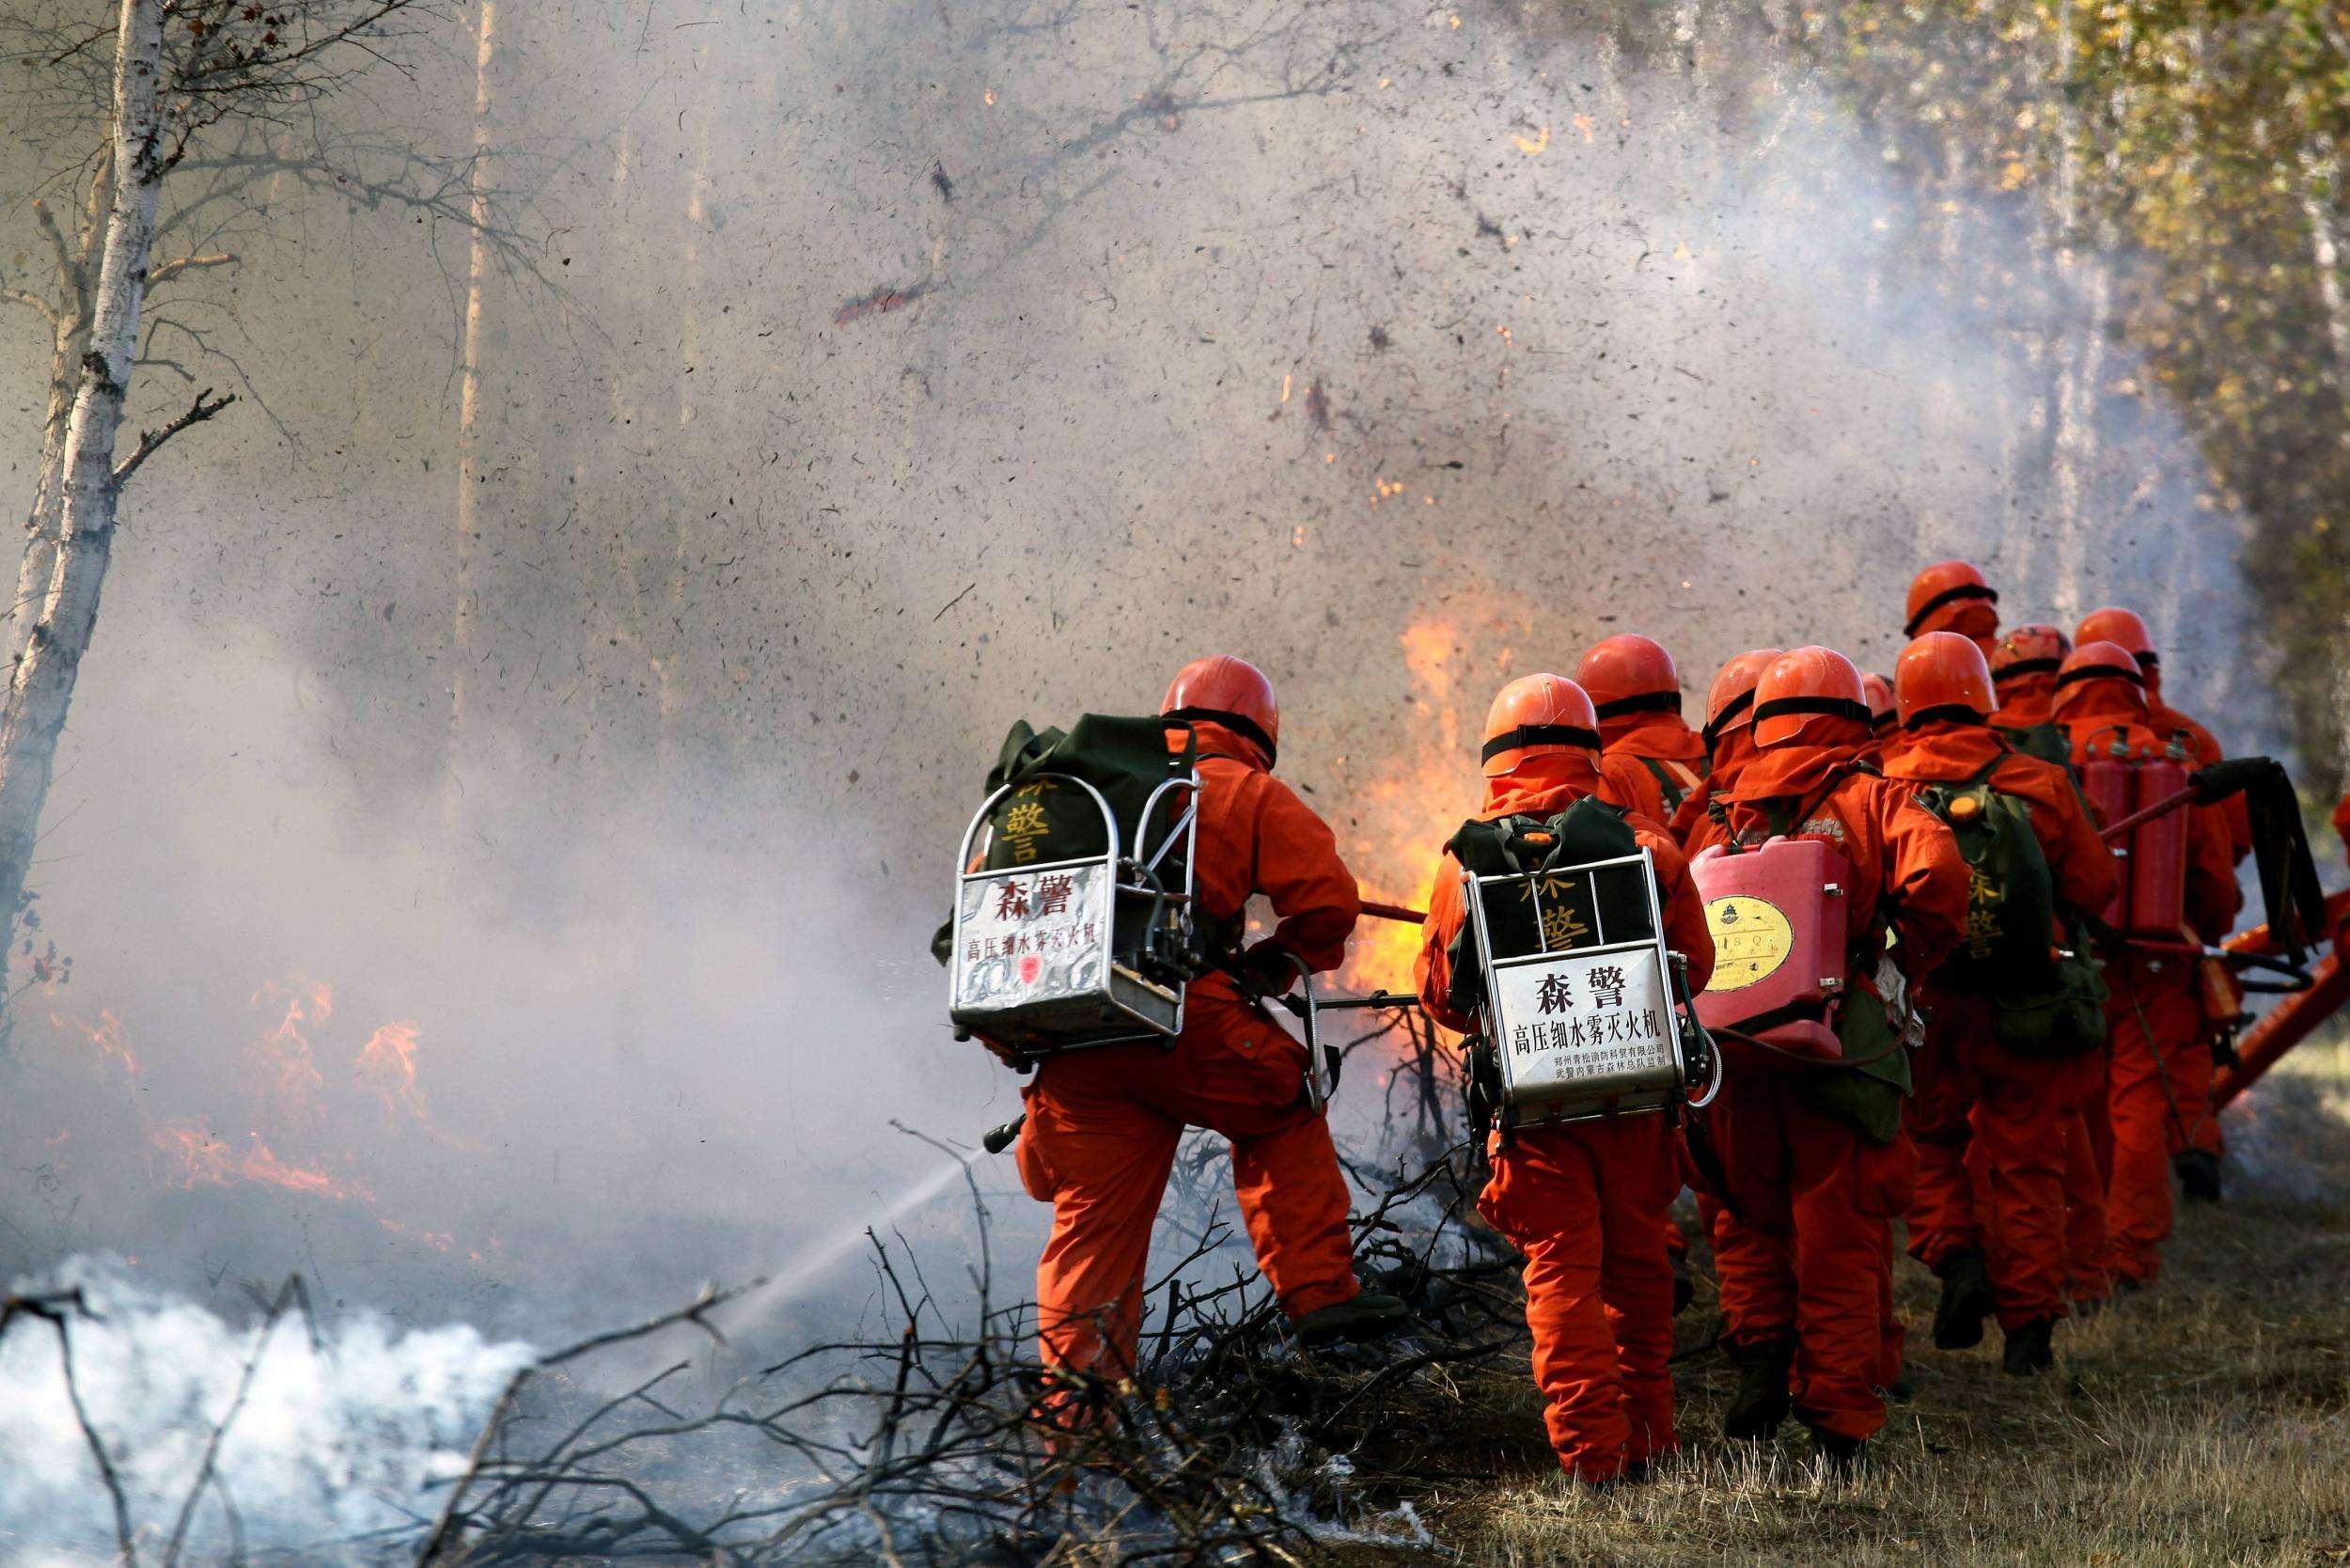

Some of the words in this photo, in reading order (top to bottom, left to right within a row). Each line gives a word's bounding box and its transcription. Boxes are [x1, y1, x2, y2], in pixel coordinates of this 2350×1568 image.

[995, 874, 1073, 921] 森警
[967, 922, 1095, 962] 高压细水雾灭火机
[1535, 965, 1626, 1015] 森警
[1512, 1008, 1661, 1056] 高压细水雾灭火机
[1556, 1056, 1666, 1078] 武警内蒙古森林总队监制
